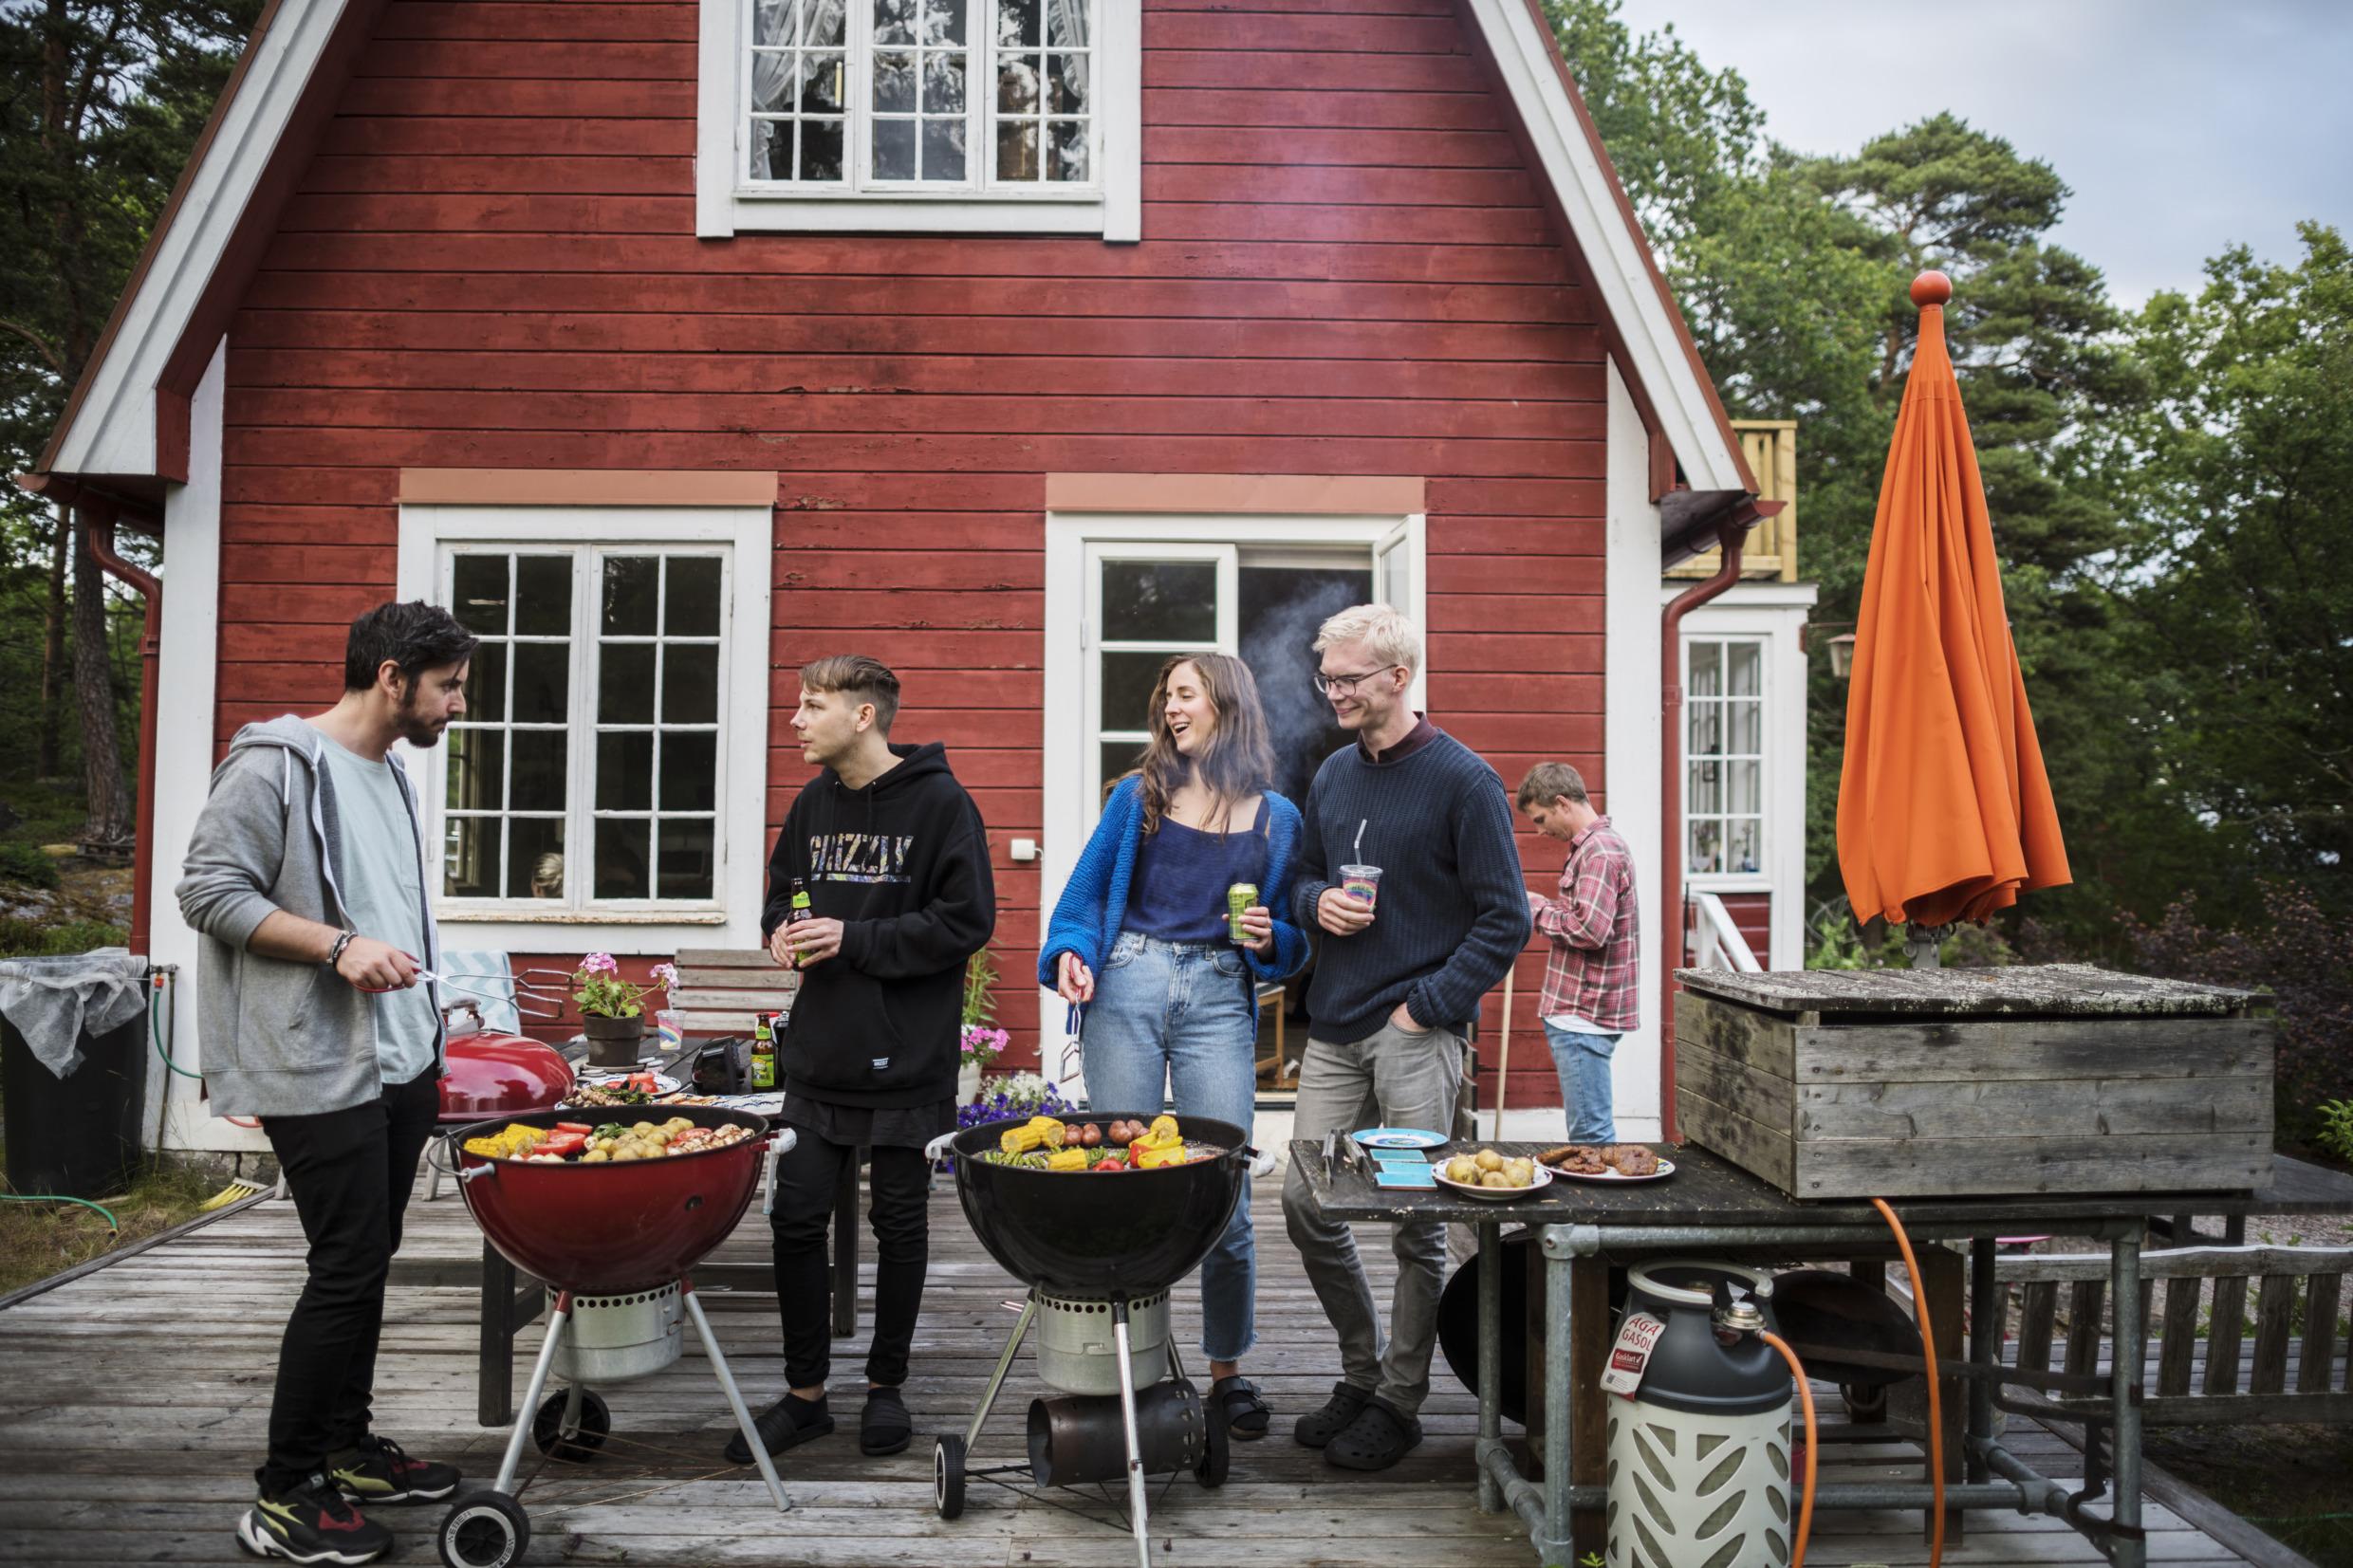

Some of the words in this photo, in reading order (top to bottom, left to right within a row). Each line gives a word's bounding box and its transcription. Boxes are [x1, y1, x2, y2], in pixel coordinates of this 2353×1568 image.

[810, 833, 914, 874] GRIZZLY
[1622, 1328, 1651, 1352] GASOL
[1629, 1317, 1659, 1336] AGA
[447, 1510, 472, 1543] WEBER
